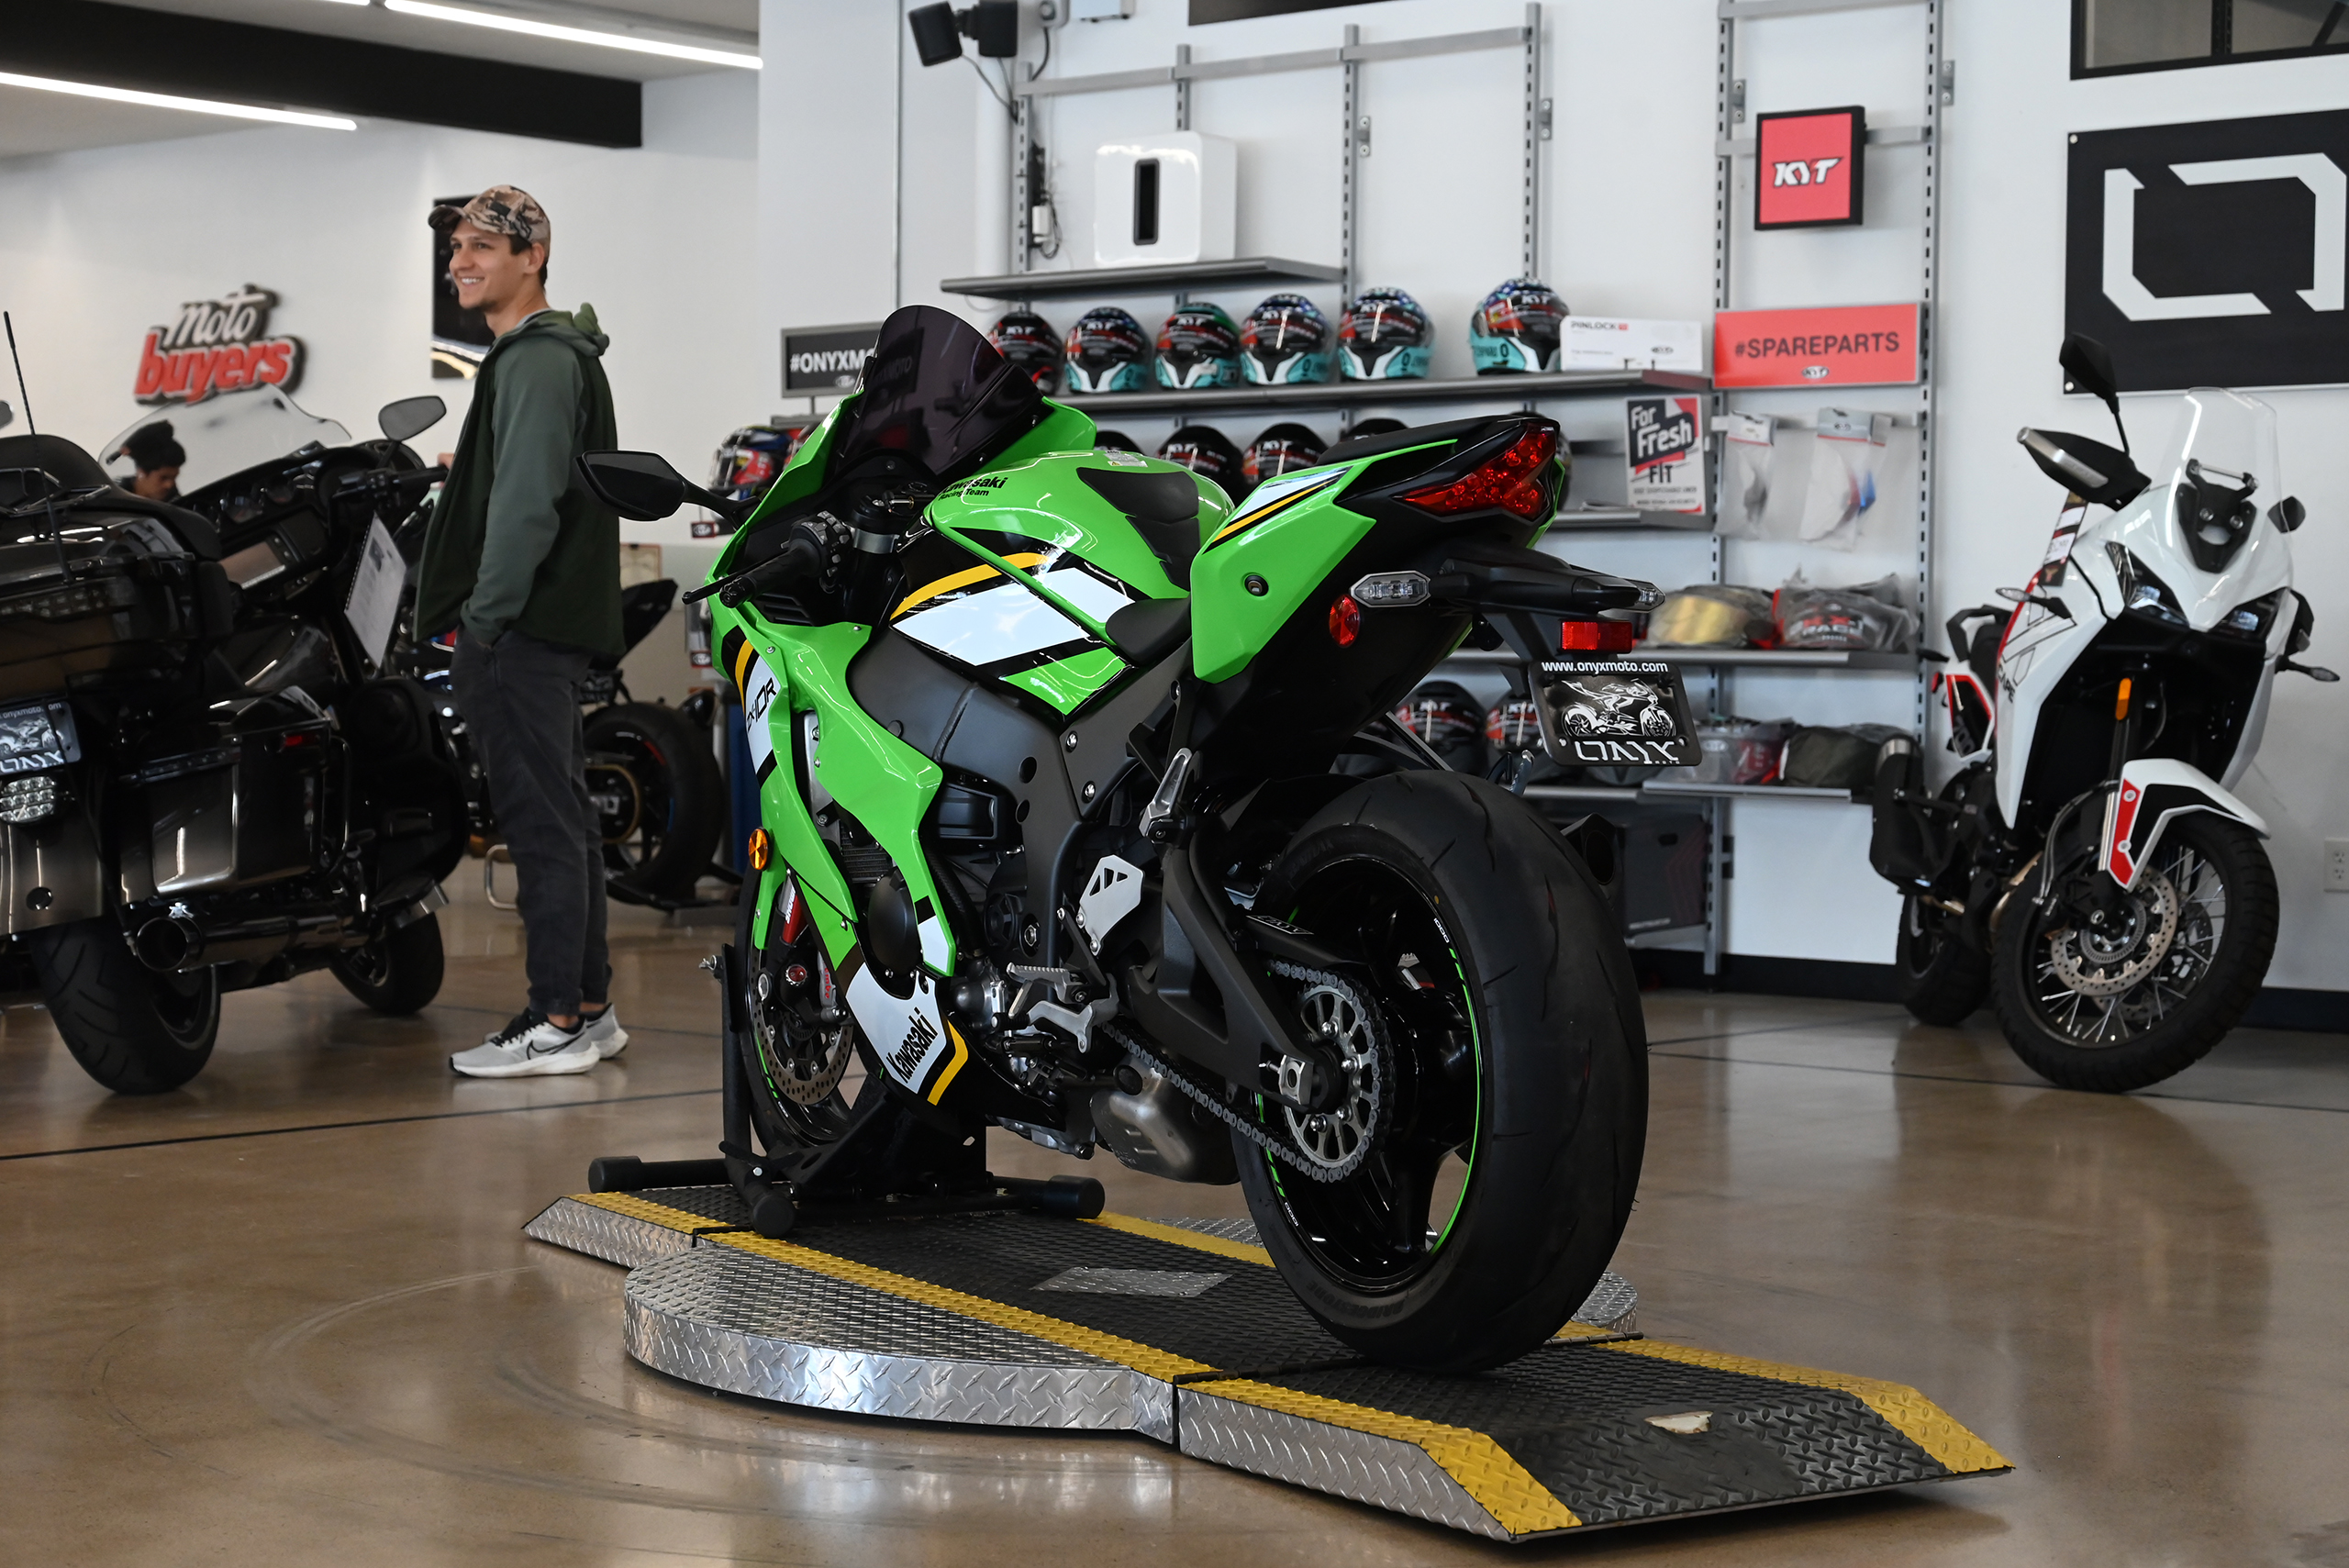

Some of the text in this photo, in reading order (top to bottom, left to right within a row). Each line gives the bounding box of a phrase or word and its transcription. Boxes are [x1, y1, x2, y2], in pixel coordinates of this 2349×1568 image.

[1773, 157, 1843, 187] KYT
[1735, 331, 1900, 359] #SPAREPARTS
[133, 331, 292, 406] buyers
[1631, 406, 1656, 429] For
[1637, 418, 1692, 458] Fresh
[1542, 661, 1669, 674] www.onyxmoto.com
[1575, 740, 1678, 764] ONYX
[885, 1006, 939, 1084] Kawasaki
